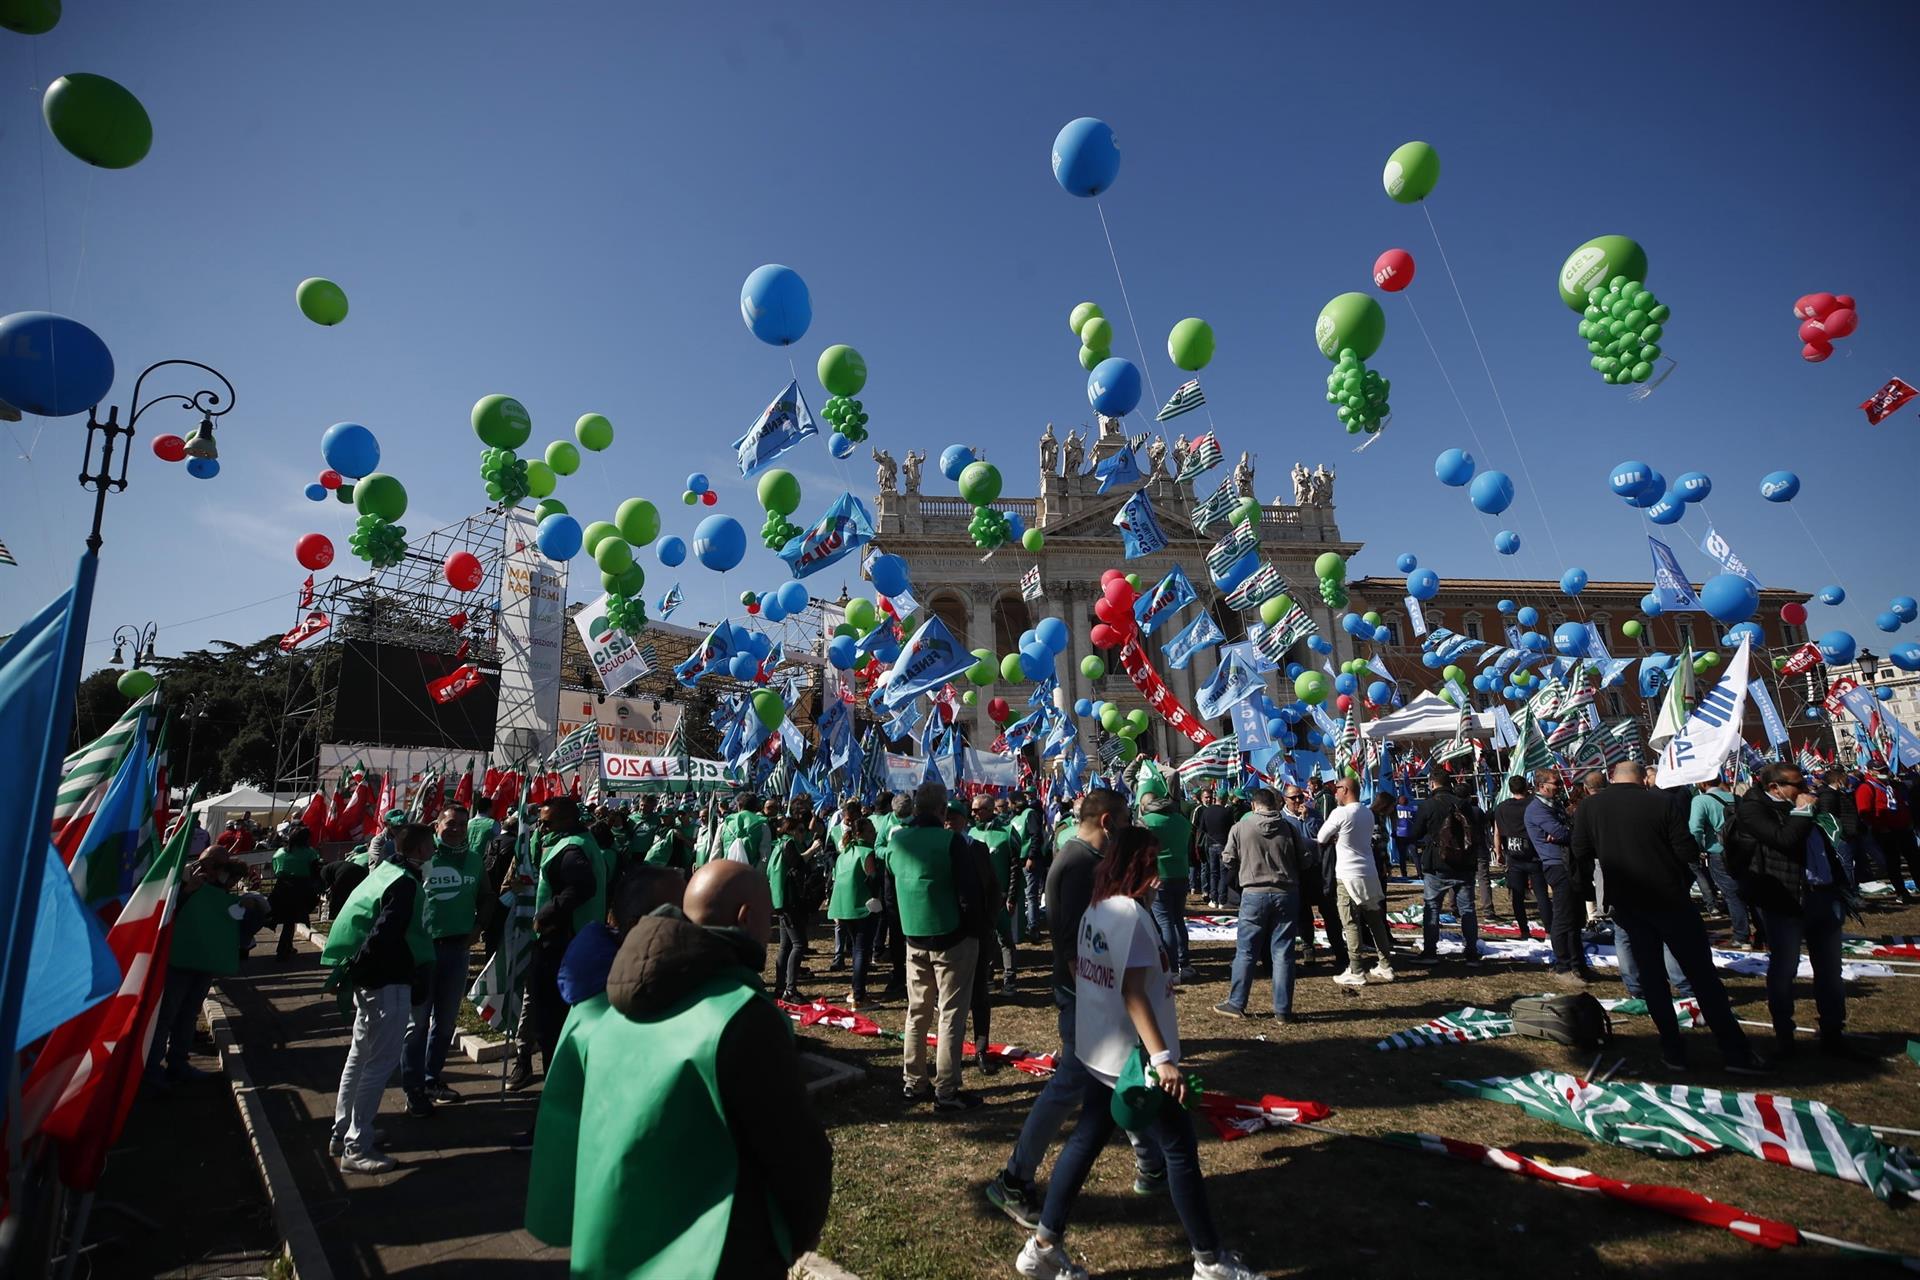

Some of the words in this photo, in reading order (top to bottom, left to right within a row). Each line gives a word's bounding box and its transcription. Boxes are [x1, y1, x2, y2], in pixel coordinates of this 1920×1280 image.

[1565, 254, 1595, 280] CISL
[1614, 471, 1642, 487] UIL
[1649, 501, 1671, 518] UIL
[508, 581, 560, 602] FASCISMI
[593, 638, 633, 666] CISL
[600, 647, 638, 676] SCUOLA
[1397, 810, 1413, 819] UIL
[430, 875, 459, 885] CISL
[463, 875, 476, 885] FP
